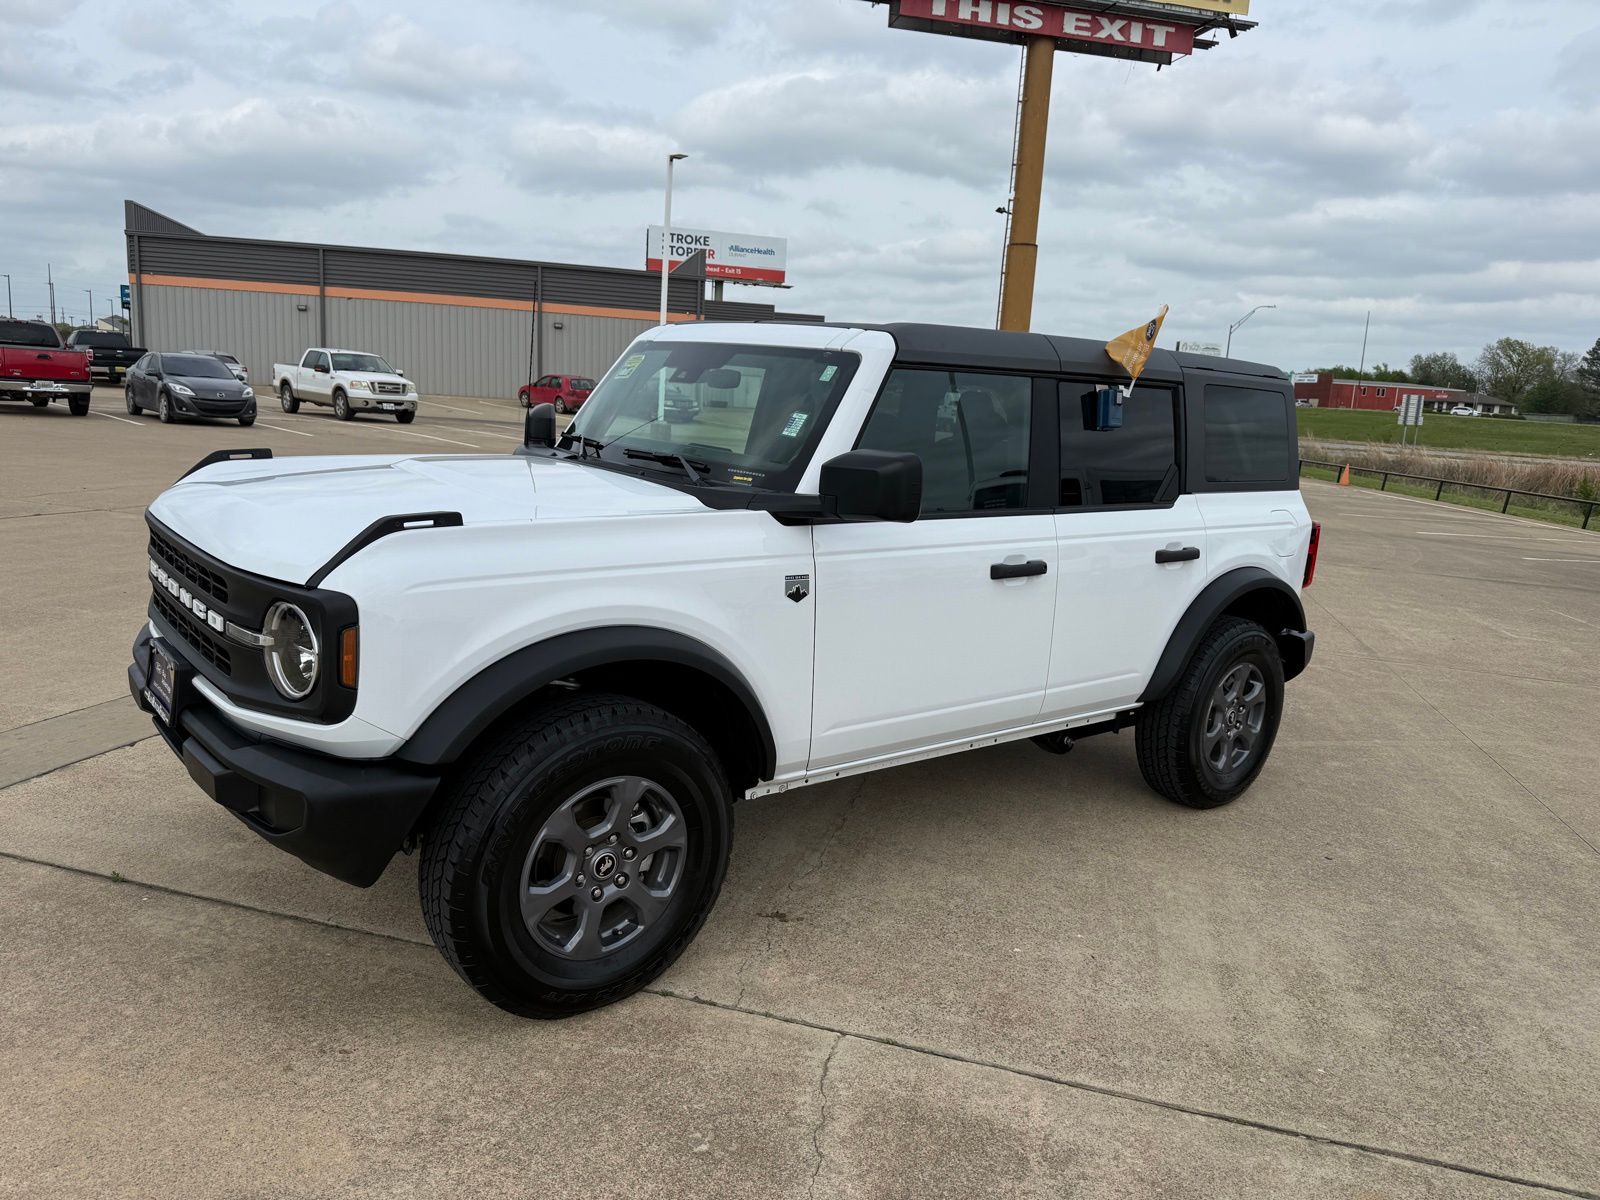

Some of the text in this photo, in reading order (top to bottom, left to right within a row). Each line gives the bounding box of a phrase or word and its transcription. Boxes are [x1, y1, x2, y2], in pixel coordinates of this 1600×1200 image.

[931, 0, 1176, 47] THIS EXIT
[662, 232, 710, 247] TROKE
[661, 245, 715, 260] TOPR
[728, 244, 776, 256] AllianceHealth
[150, 559, 224, 632] BRONCO
